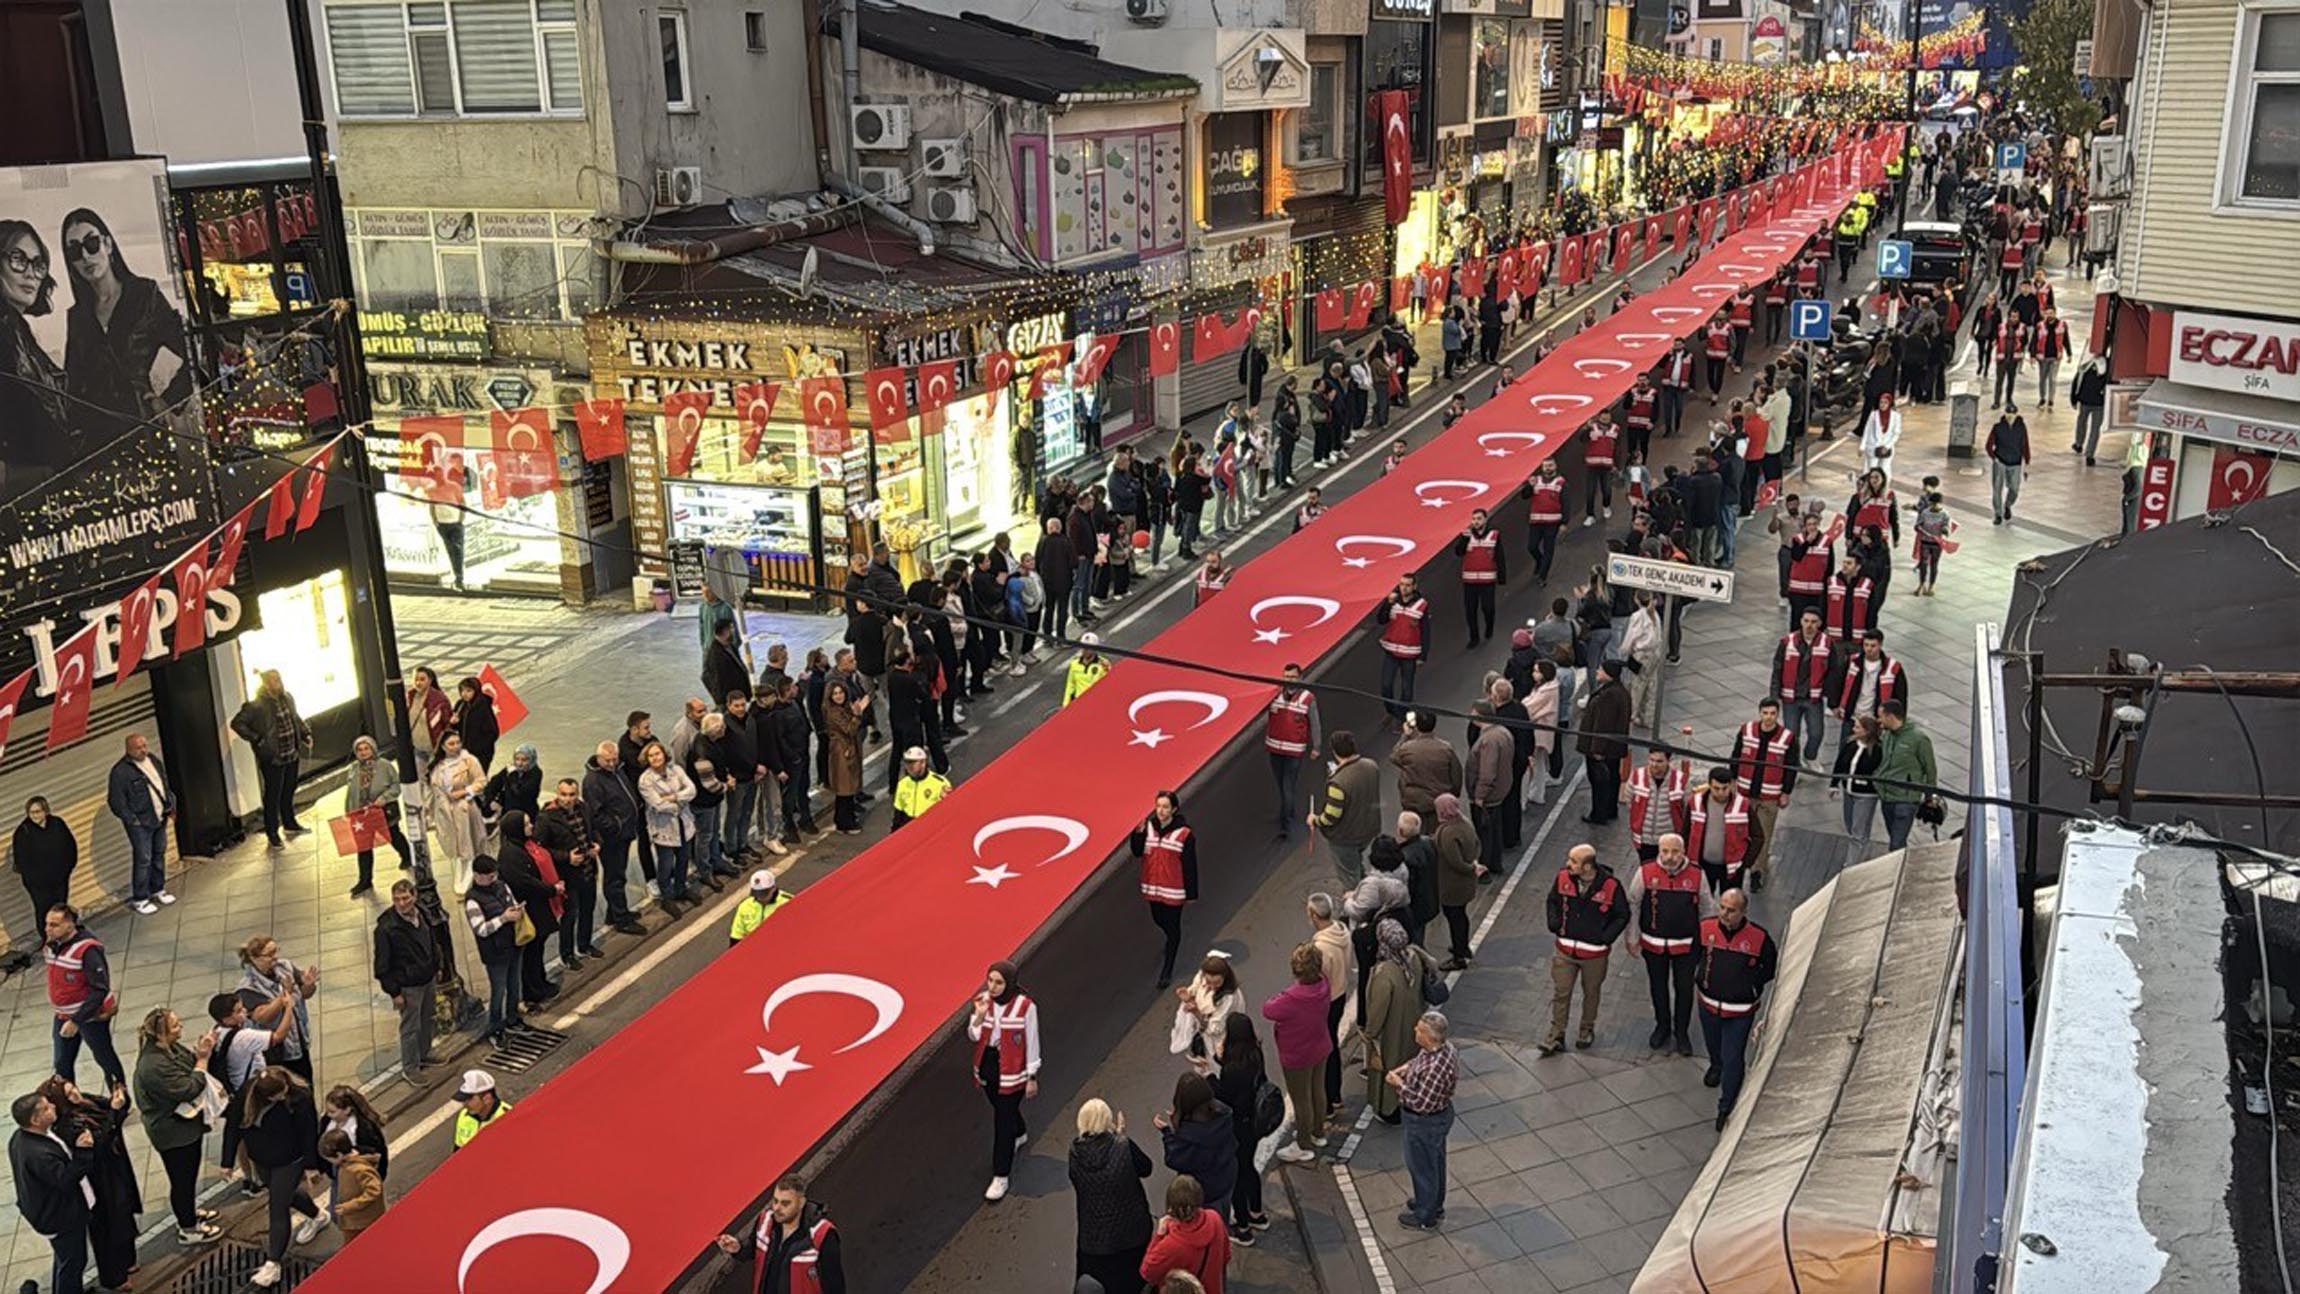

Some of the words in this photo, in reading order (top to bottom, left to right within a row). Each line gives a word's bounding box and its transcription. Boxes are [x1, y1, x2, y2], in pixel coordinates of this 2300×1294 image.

[2003, 147, 2019, 166] P
[1881, 245, 1901, 273] P
[1800, 305, 1823, 336] P
[628, 340, 750, 369] EKMEK
[898, 327, 962, 367] EKMEK
[2244, 373, 2270, 390] ŞİFA
[2162, 411, 2208, 432] ŞİFA
[9, 496, 198, 570] WWW.MADAMLEPS.COM
[1628, 563, 1642, 578] TEK
[1644, 566, 1666, 583] GENÇ
